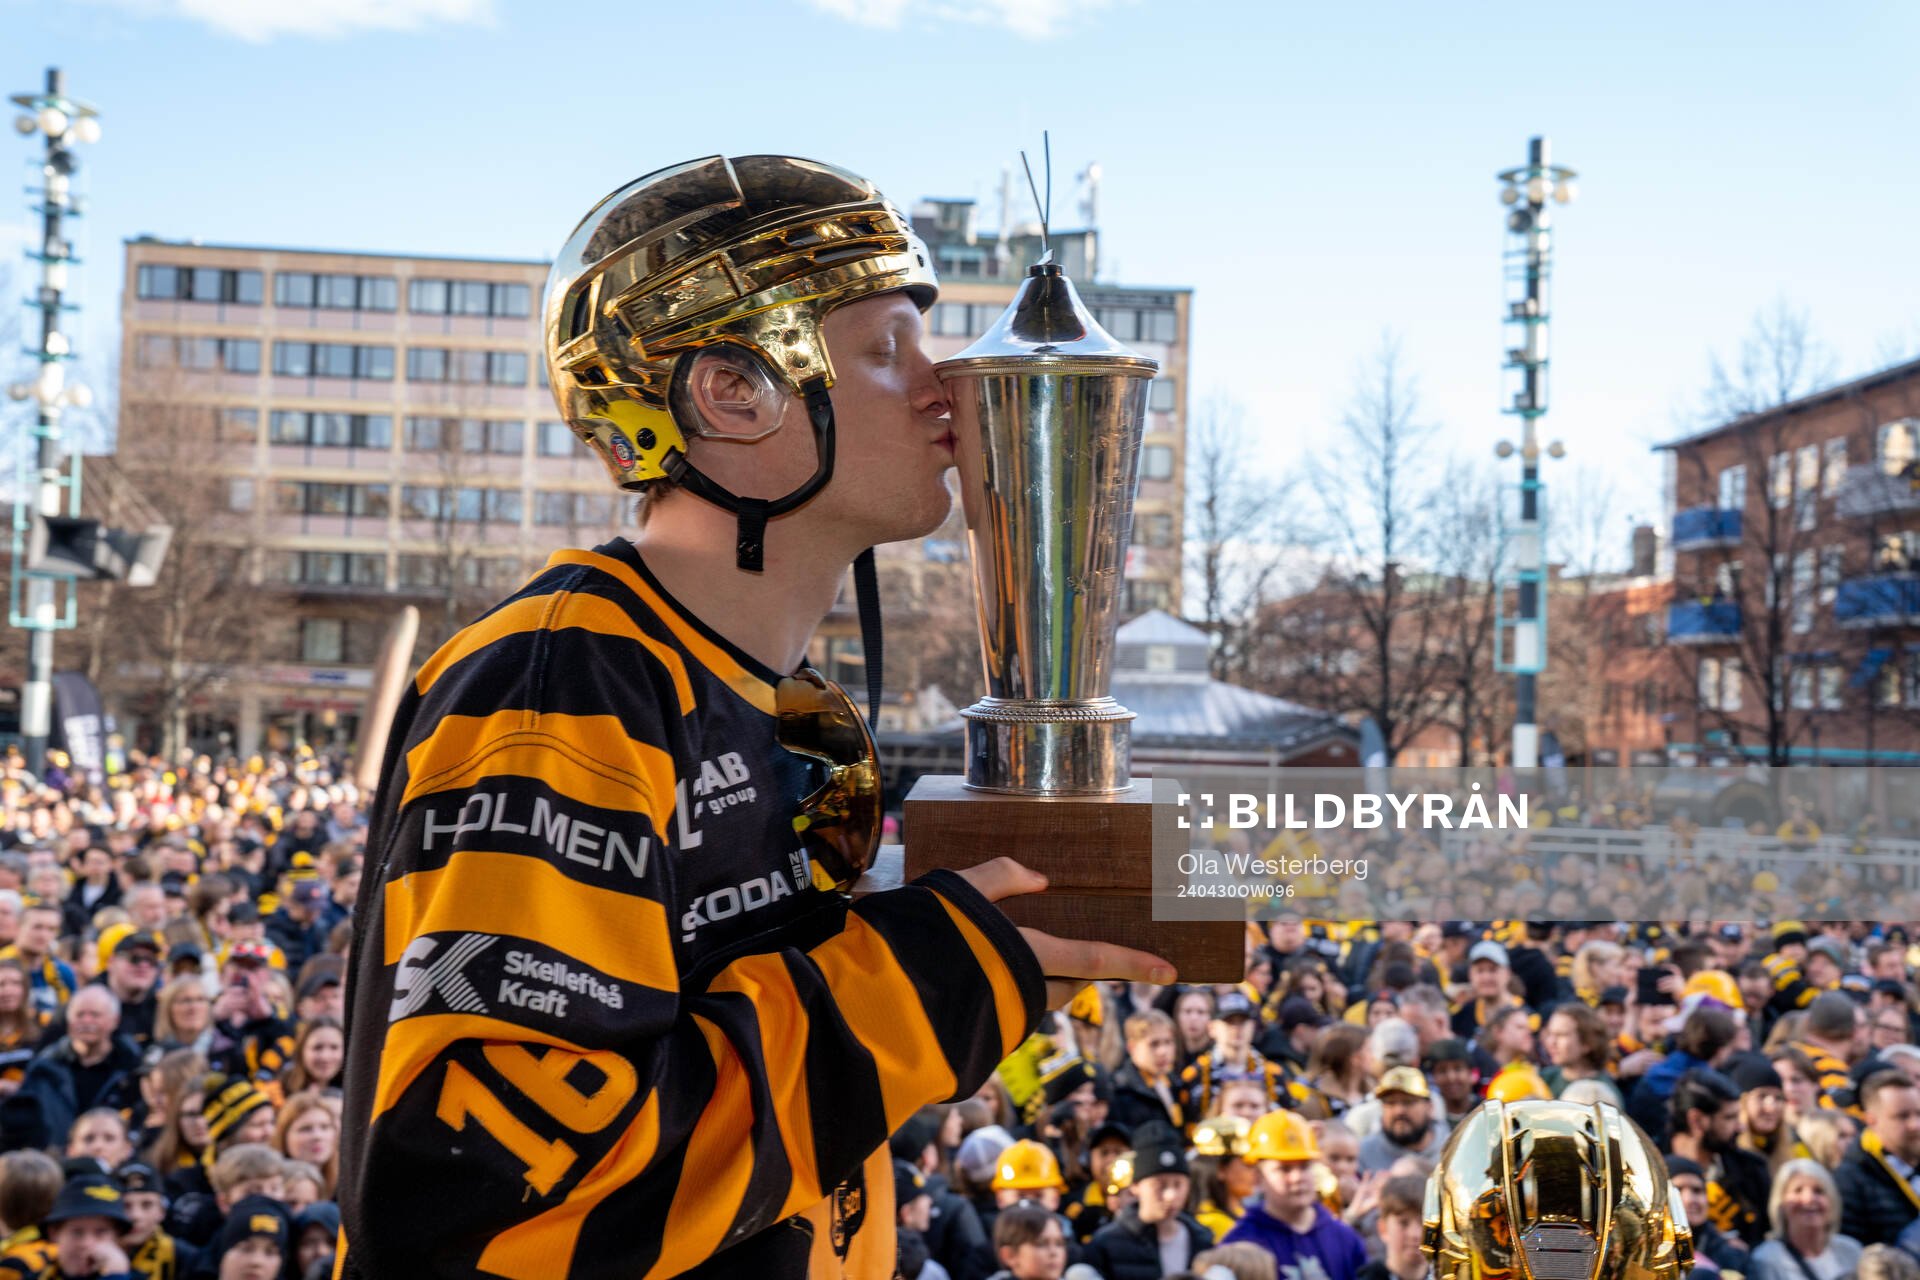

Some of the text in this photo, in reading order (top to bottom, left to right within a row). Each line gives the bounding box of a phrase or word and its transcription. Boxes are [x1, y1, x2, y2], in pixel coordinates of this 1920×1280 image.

[708, 787, 757, 815] group
[423, 793, 650, 878] HOLMEN
[498, 978, 569, 1019] Kraft
[504, 950, 624, 1010] Skellefteå
